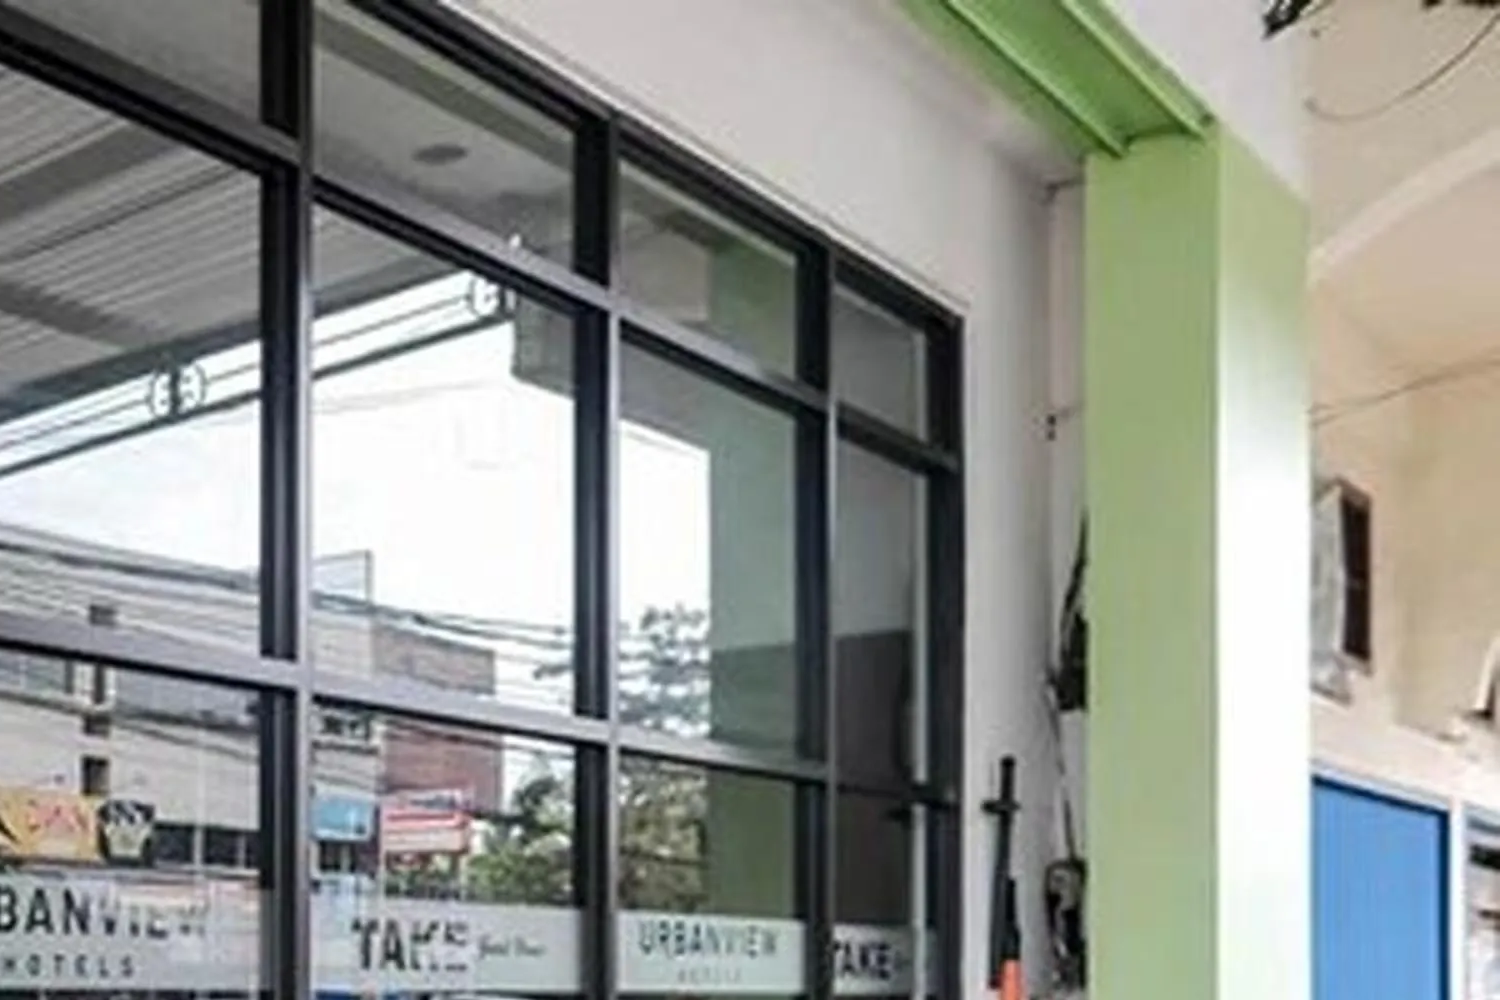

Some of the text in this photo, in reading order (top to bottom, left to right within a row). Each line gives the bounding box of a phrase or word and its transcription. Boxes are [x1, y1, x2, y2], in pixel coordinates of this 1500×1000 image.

[351, 917, 468, 971] TAKE
[639, 920, 778, 960] URBANVIEW
[3, 953, 135, 978] HOTELS
